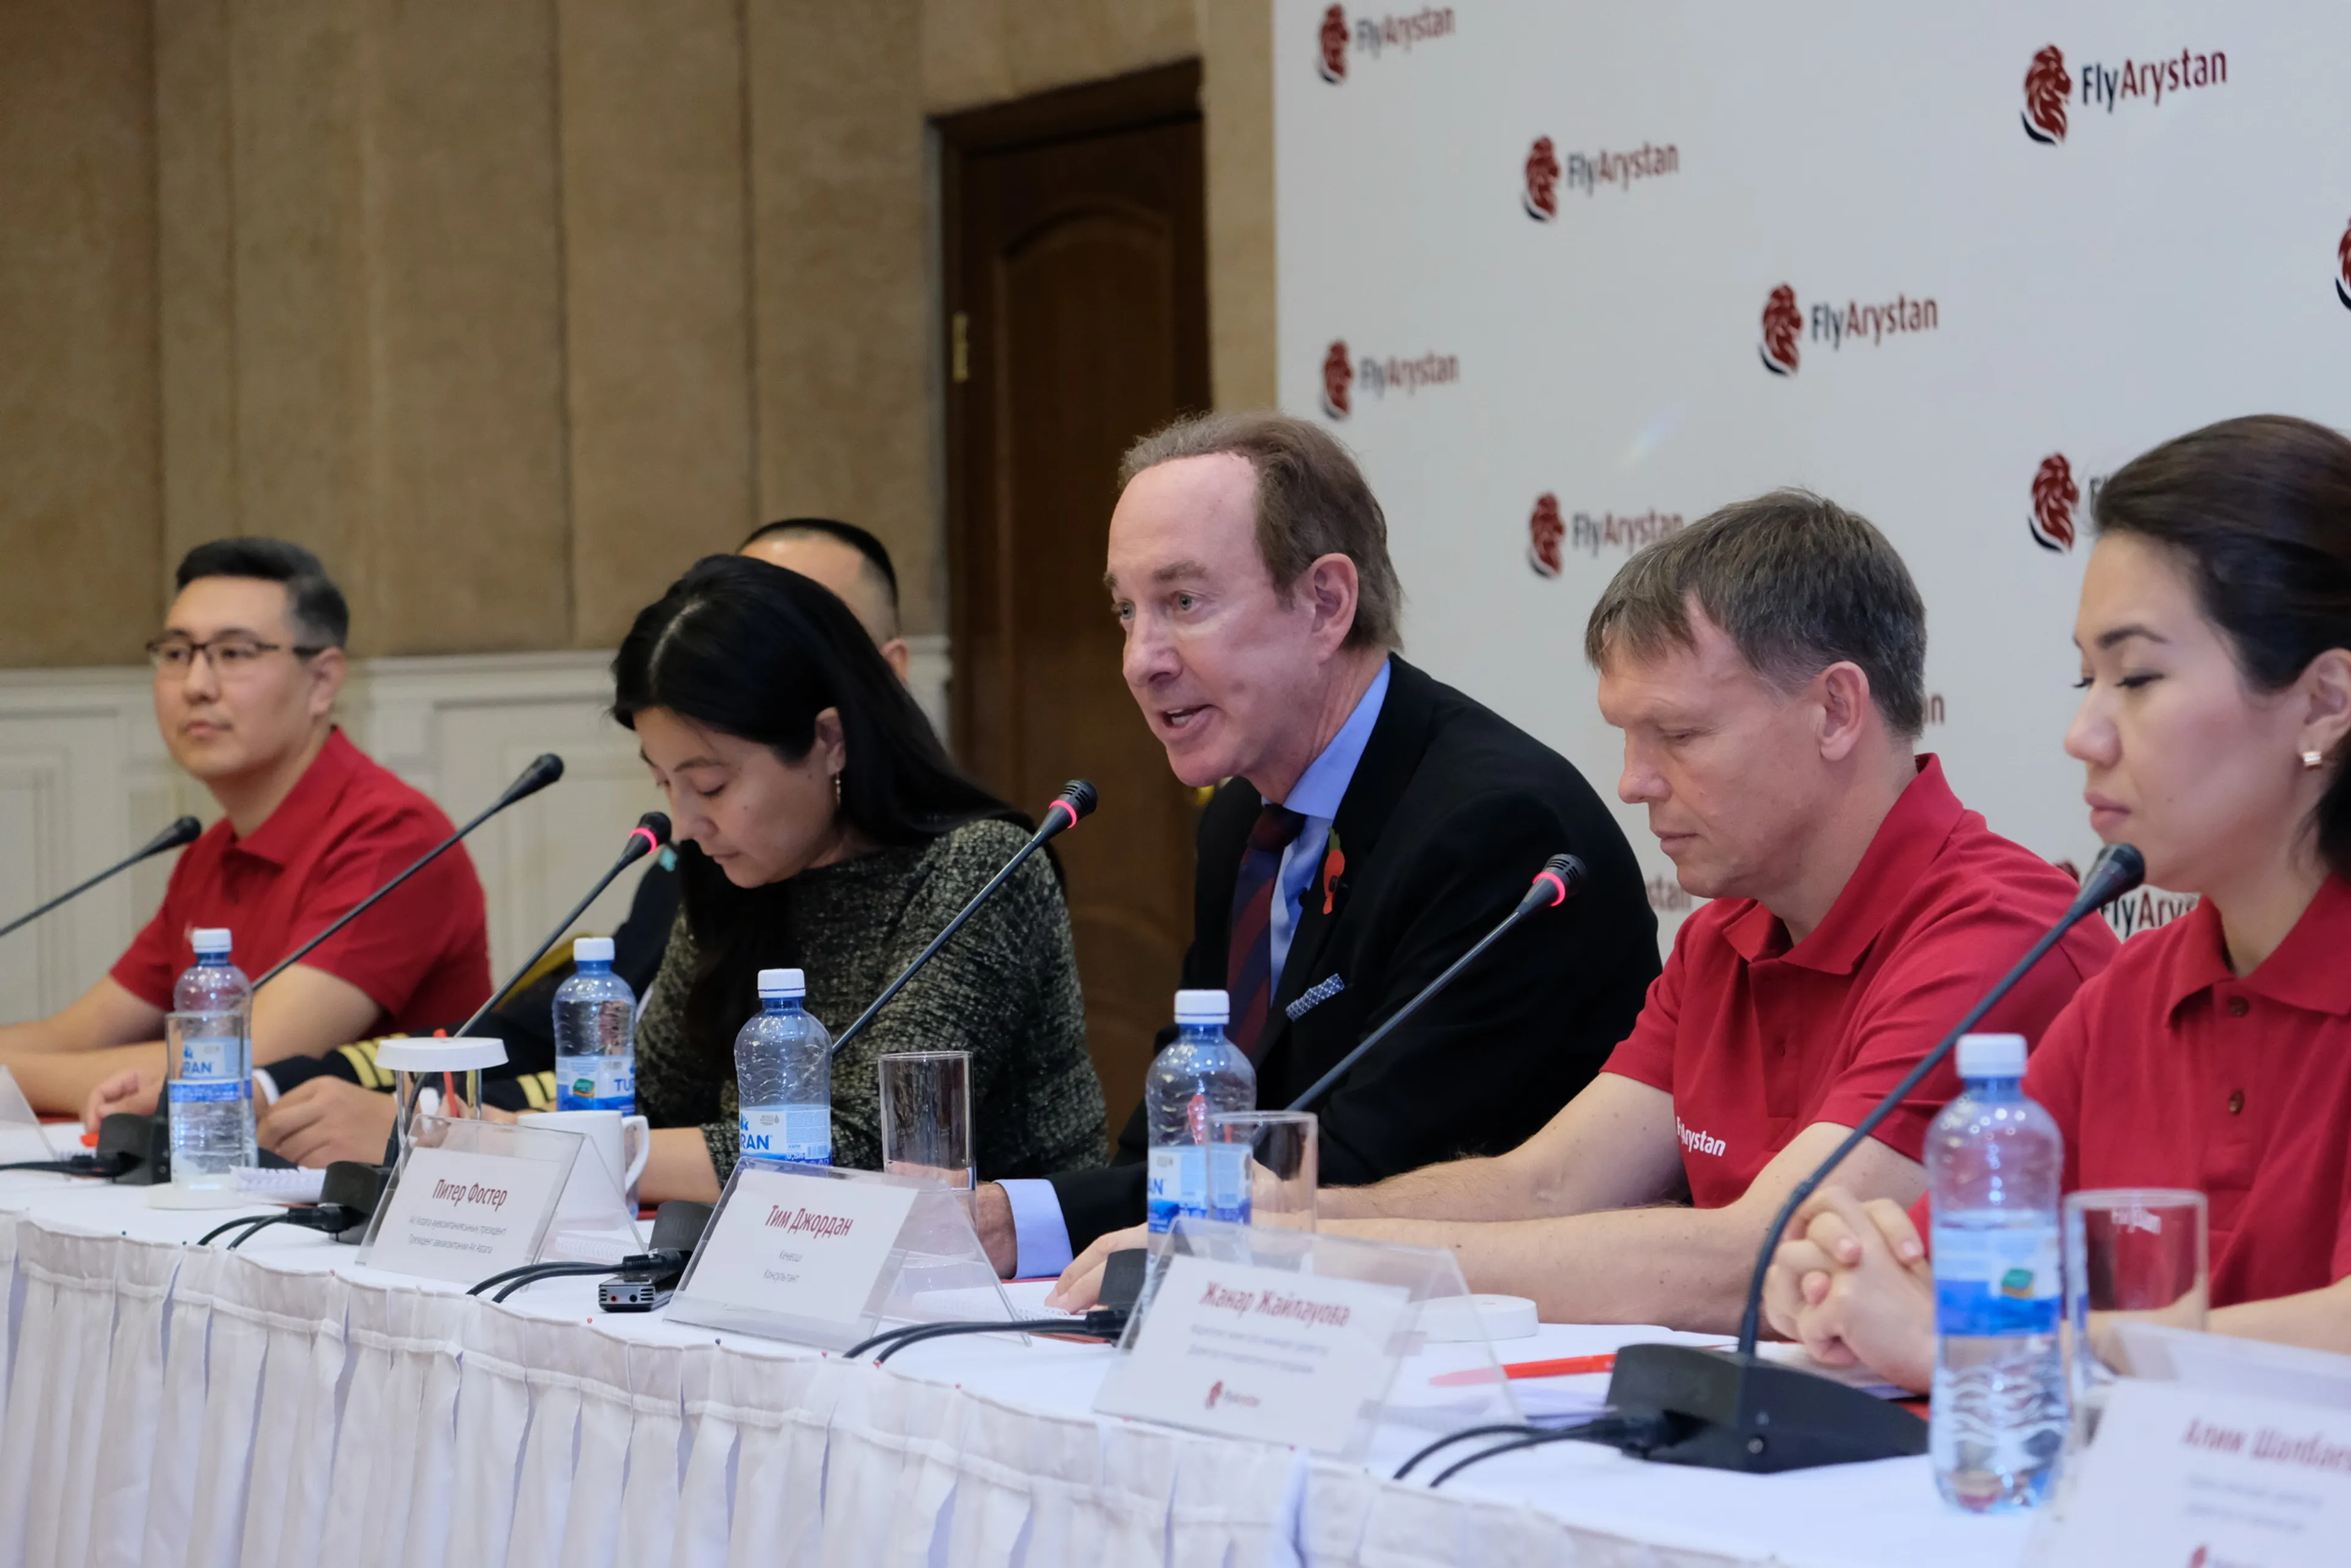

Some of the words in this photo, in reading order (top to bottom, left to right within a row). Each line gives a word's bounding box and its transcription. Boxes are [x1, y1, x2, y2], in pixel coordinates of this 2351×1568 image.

[1355, 6, 1455, 58] FlyArystan
[2082, 48, 2227, 113] FlyArystan
[1567, 142, 1679, 196] FlyArystan
[1811, 294, 1938, 351] FlyArystan
[1360, 351, 1460, 397] FlyArystan
[432, 1179, 467, 1207] Питер
[467, 1182, 508, 1212] Фостер
[765, 1205, 792, 1229] Тим
[787, 1208, 854, 1239] Джордан
[1198, 1281, 1254, 1319] Жанар
